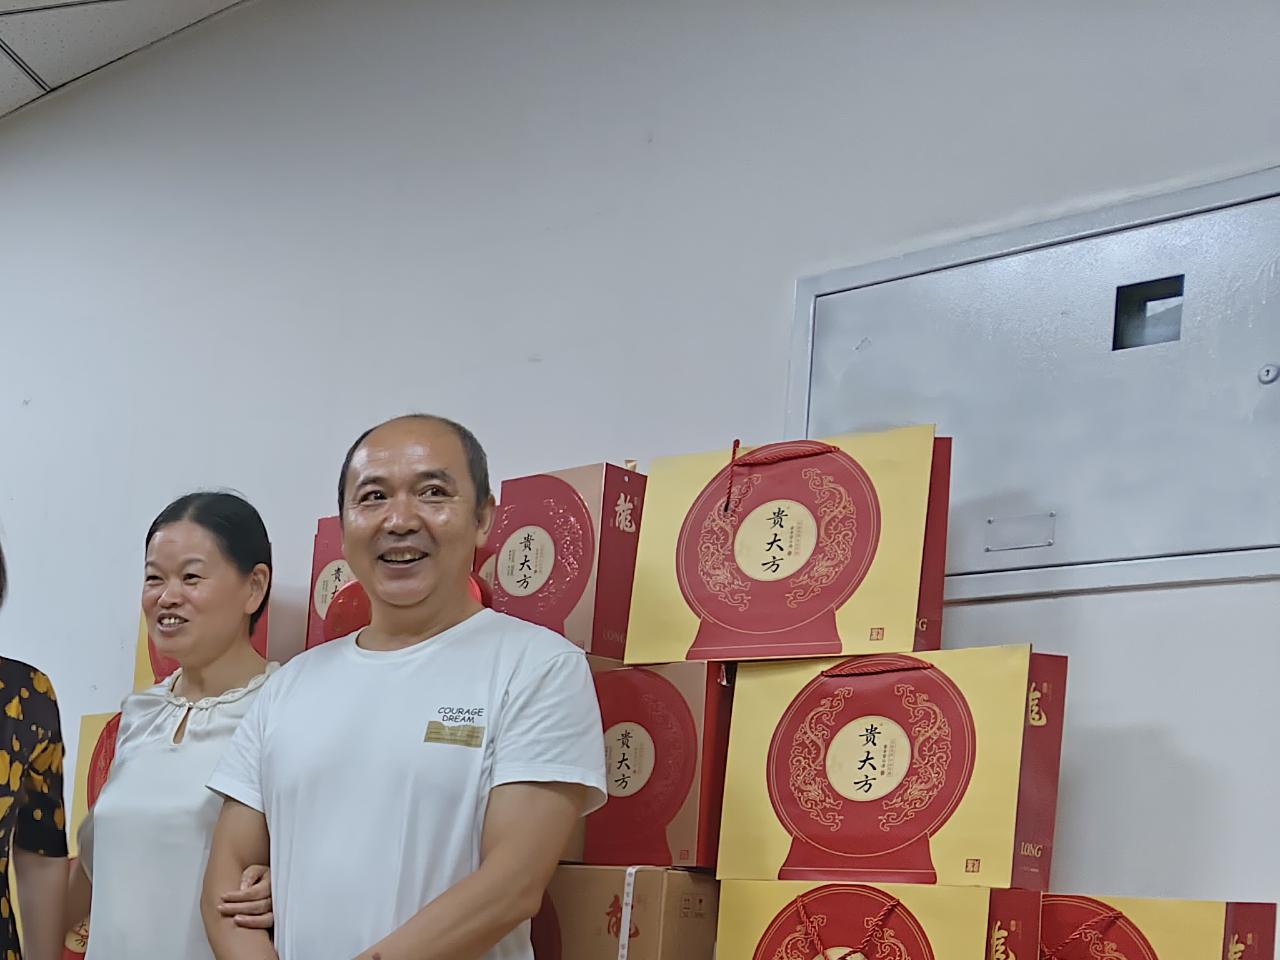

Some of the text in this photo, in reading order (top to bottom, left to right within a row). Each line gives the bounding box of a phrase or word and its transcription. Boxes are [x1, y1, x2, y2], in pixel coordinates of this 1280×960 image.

[516, 533, 535, 590] 贵大方
[761, 507, 788, 574] 贵大方
[437, 706, 485, 717] COURAGE
[442, 714, 475, 724] DREAM
[614, 729, 633, 790] 贵大方
[853, 723, 882, 793] 贵大方
[1020, 841, 1042, 858] LONG
